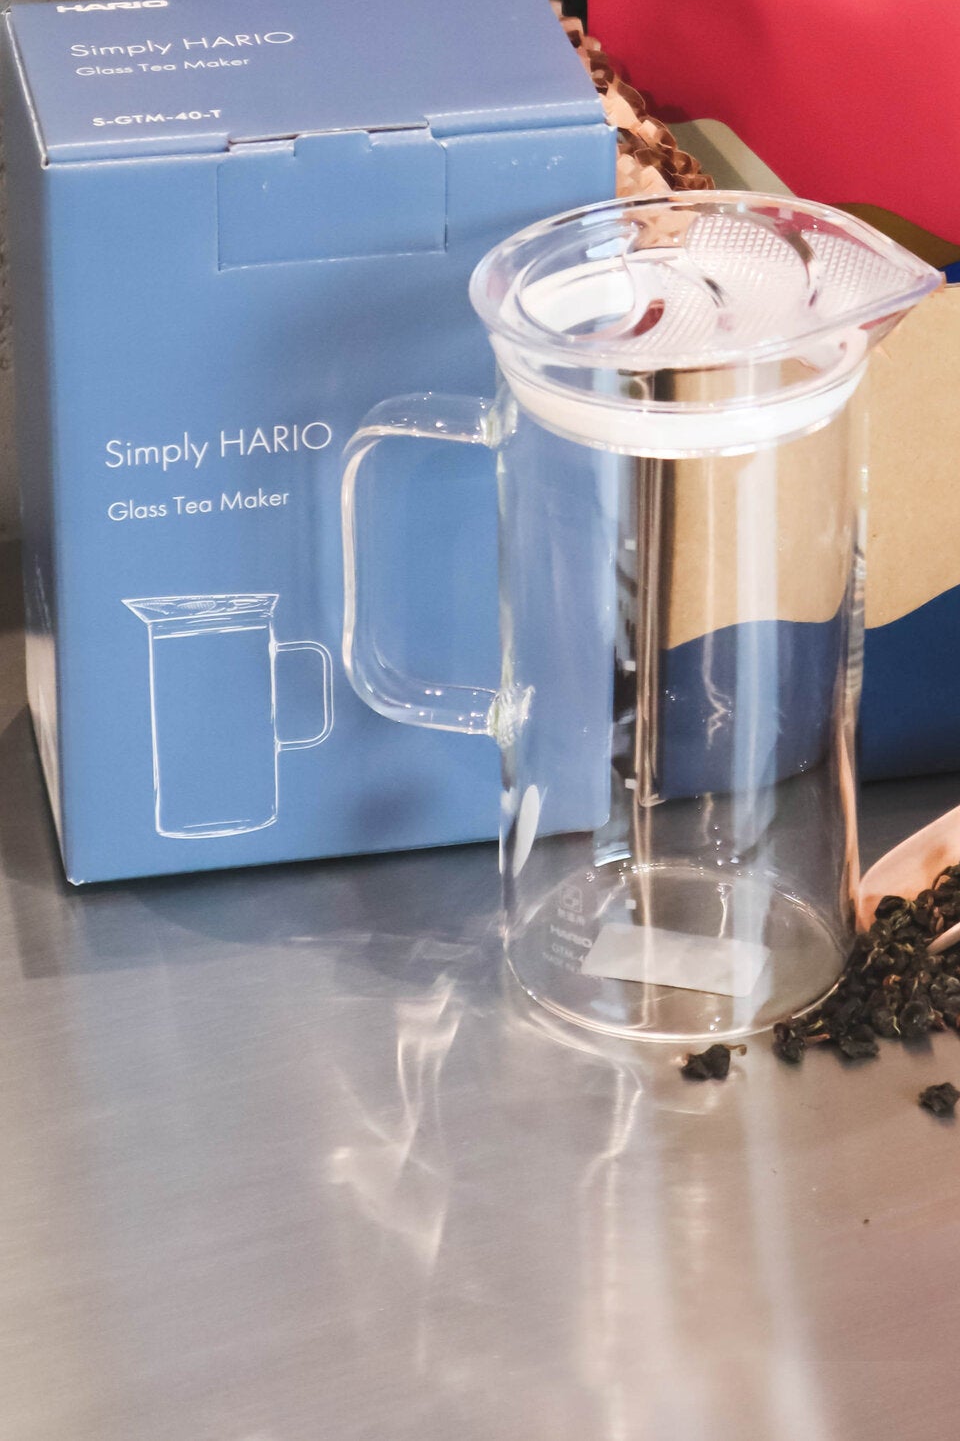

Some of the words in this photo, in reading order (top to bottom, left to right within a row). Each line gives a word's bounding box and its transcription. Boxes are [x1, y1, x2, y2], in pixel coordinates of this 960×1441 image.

[56, 0, 168, 13] HARIO
[70, 40, 172, 57] Simply
[182, 32, 294, 49] HARIO
[76, 65, 133, 76] Glass
[138, 63, 176, 72] Tea
[184, 58, 250, 70] Maker
[93, 109, 222, 127] S-GTM-40-T
[105, 431, 209, 471] Simply
[220, 422, 332, 457] HARIO
[108, 499, 167, 521] Glass
[173, 496, 212, 515] Tea
[220, 488, 289, 511] Maker
